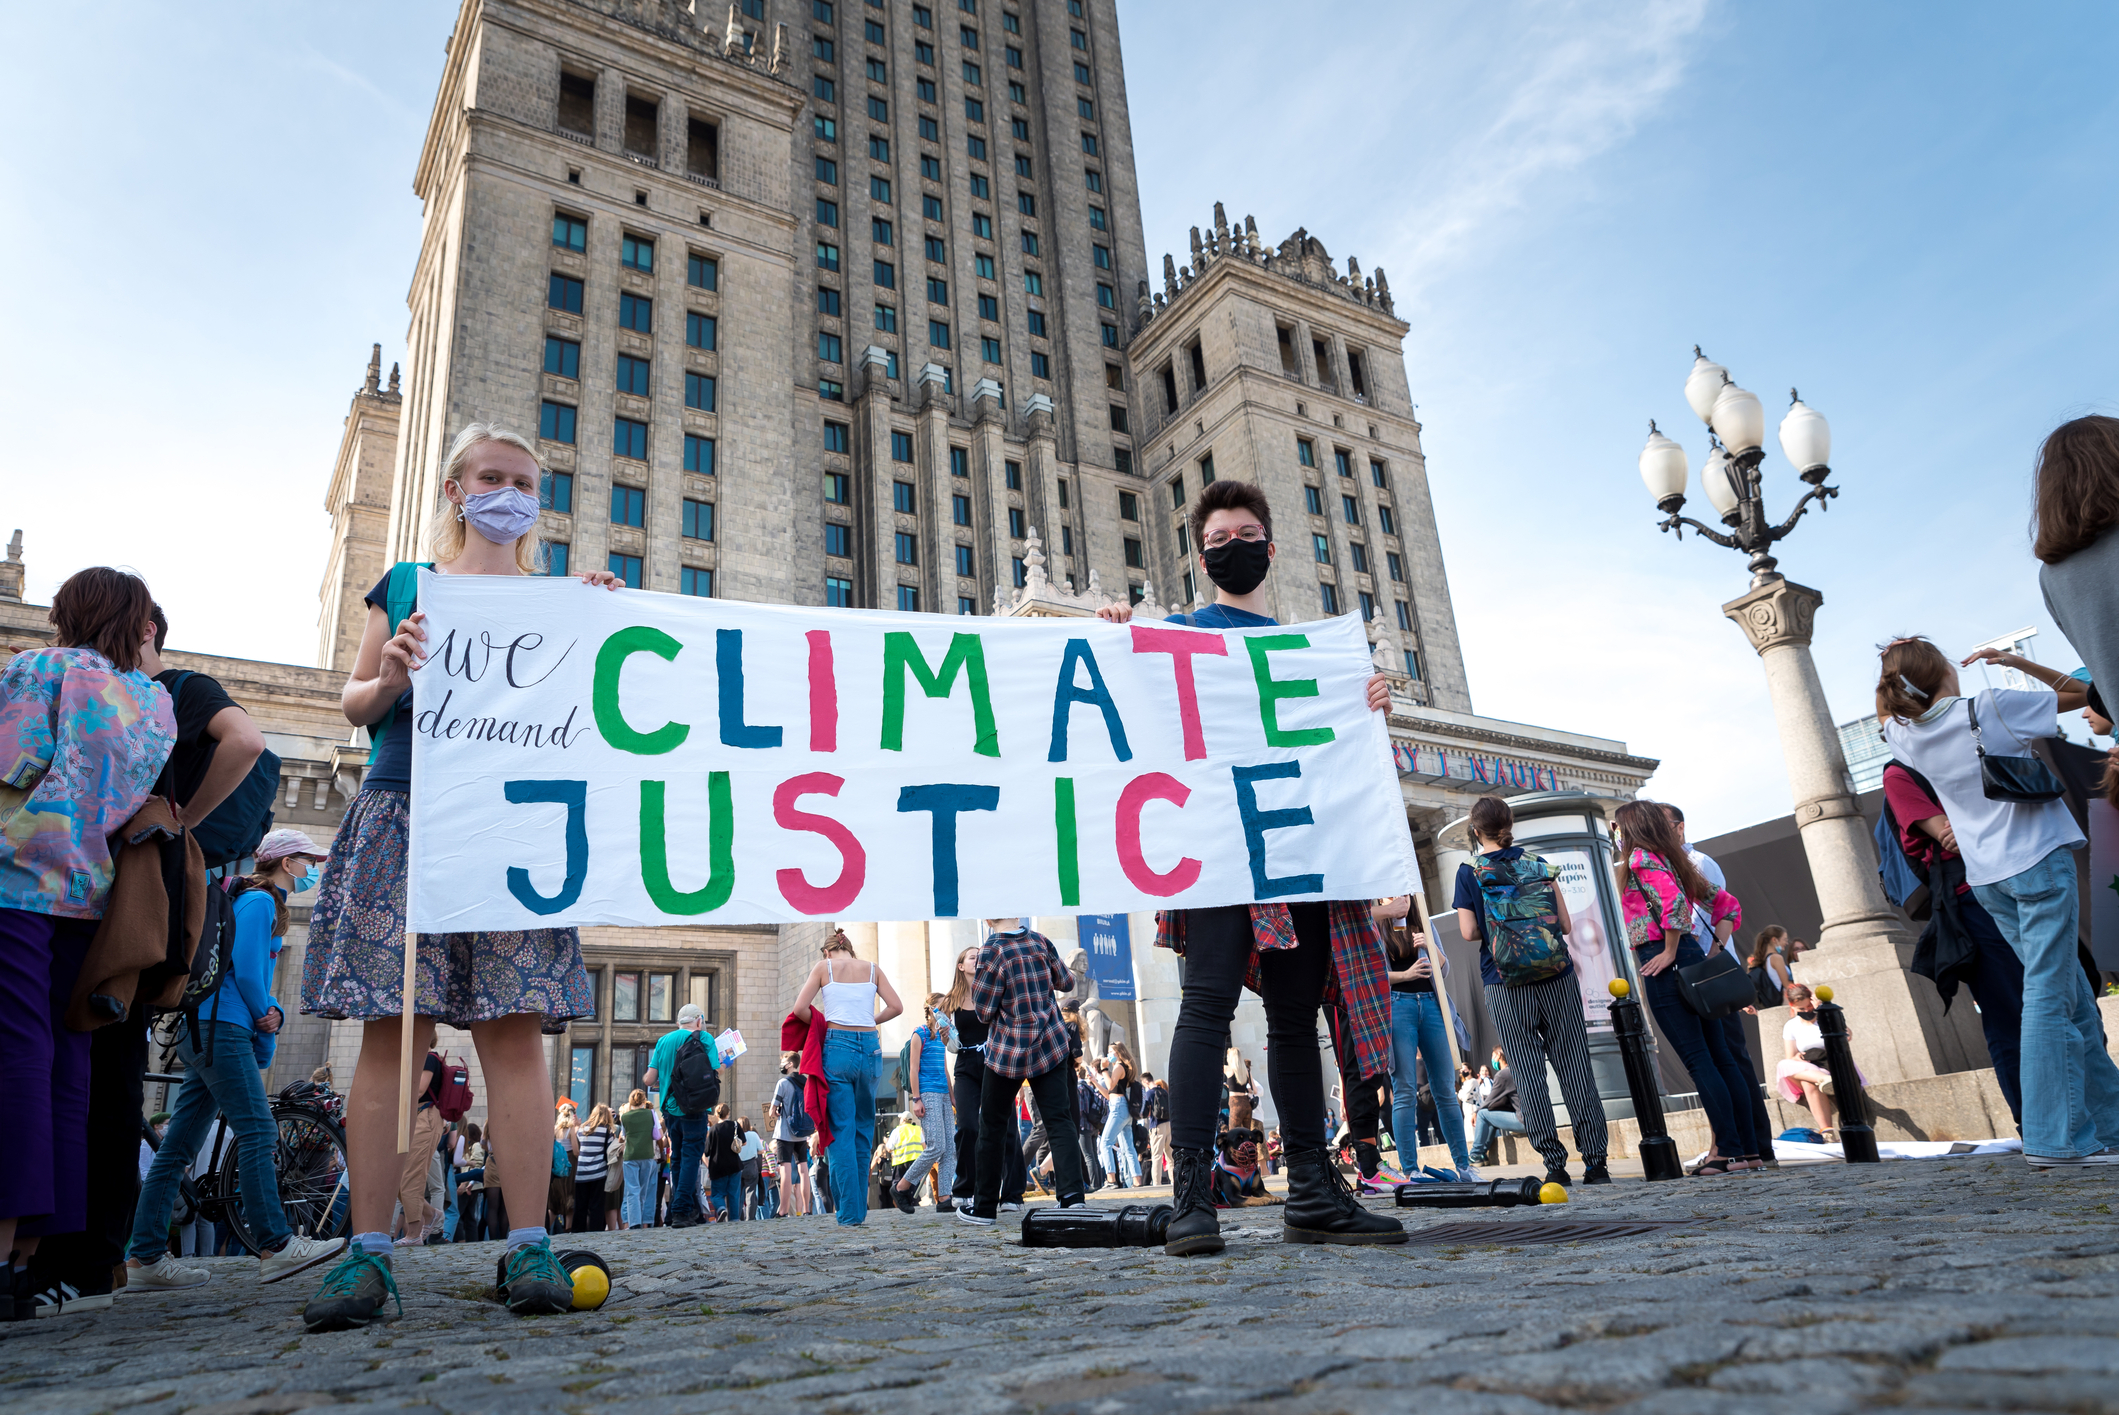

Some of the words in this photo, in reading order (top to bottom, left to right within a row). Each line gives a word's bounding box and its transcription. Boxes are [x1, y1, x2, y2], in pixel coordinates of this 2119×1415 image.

[413, 690, 591, 749] demand
[592, 625, 1336, 762] CLIMATE
[1438, 752, 1450, 776] I
[1468, 756, 1560, 792] NAUKI
[504, 758, 1325, 917] JUSTICE
